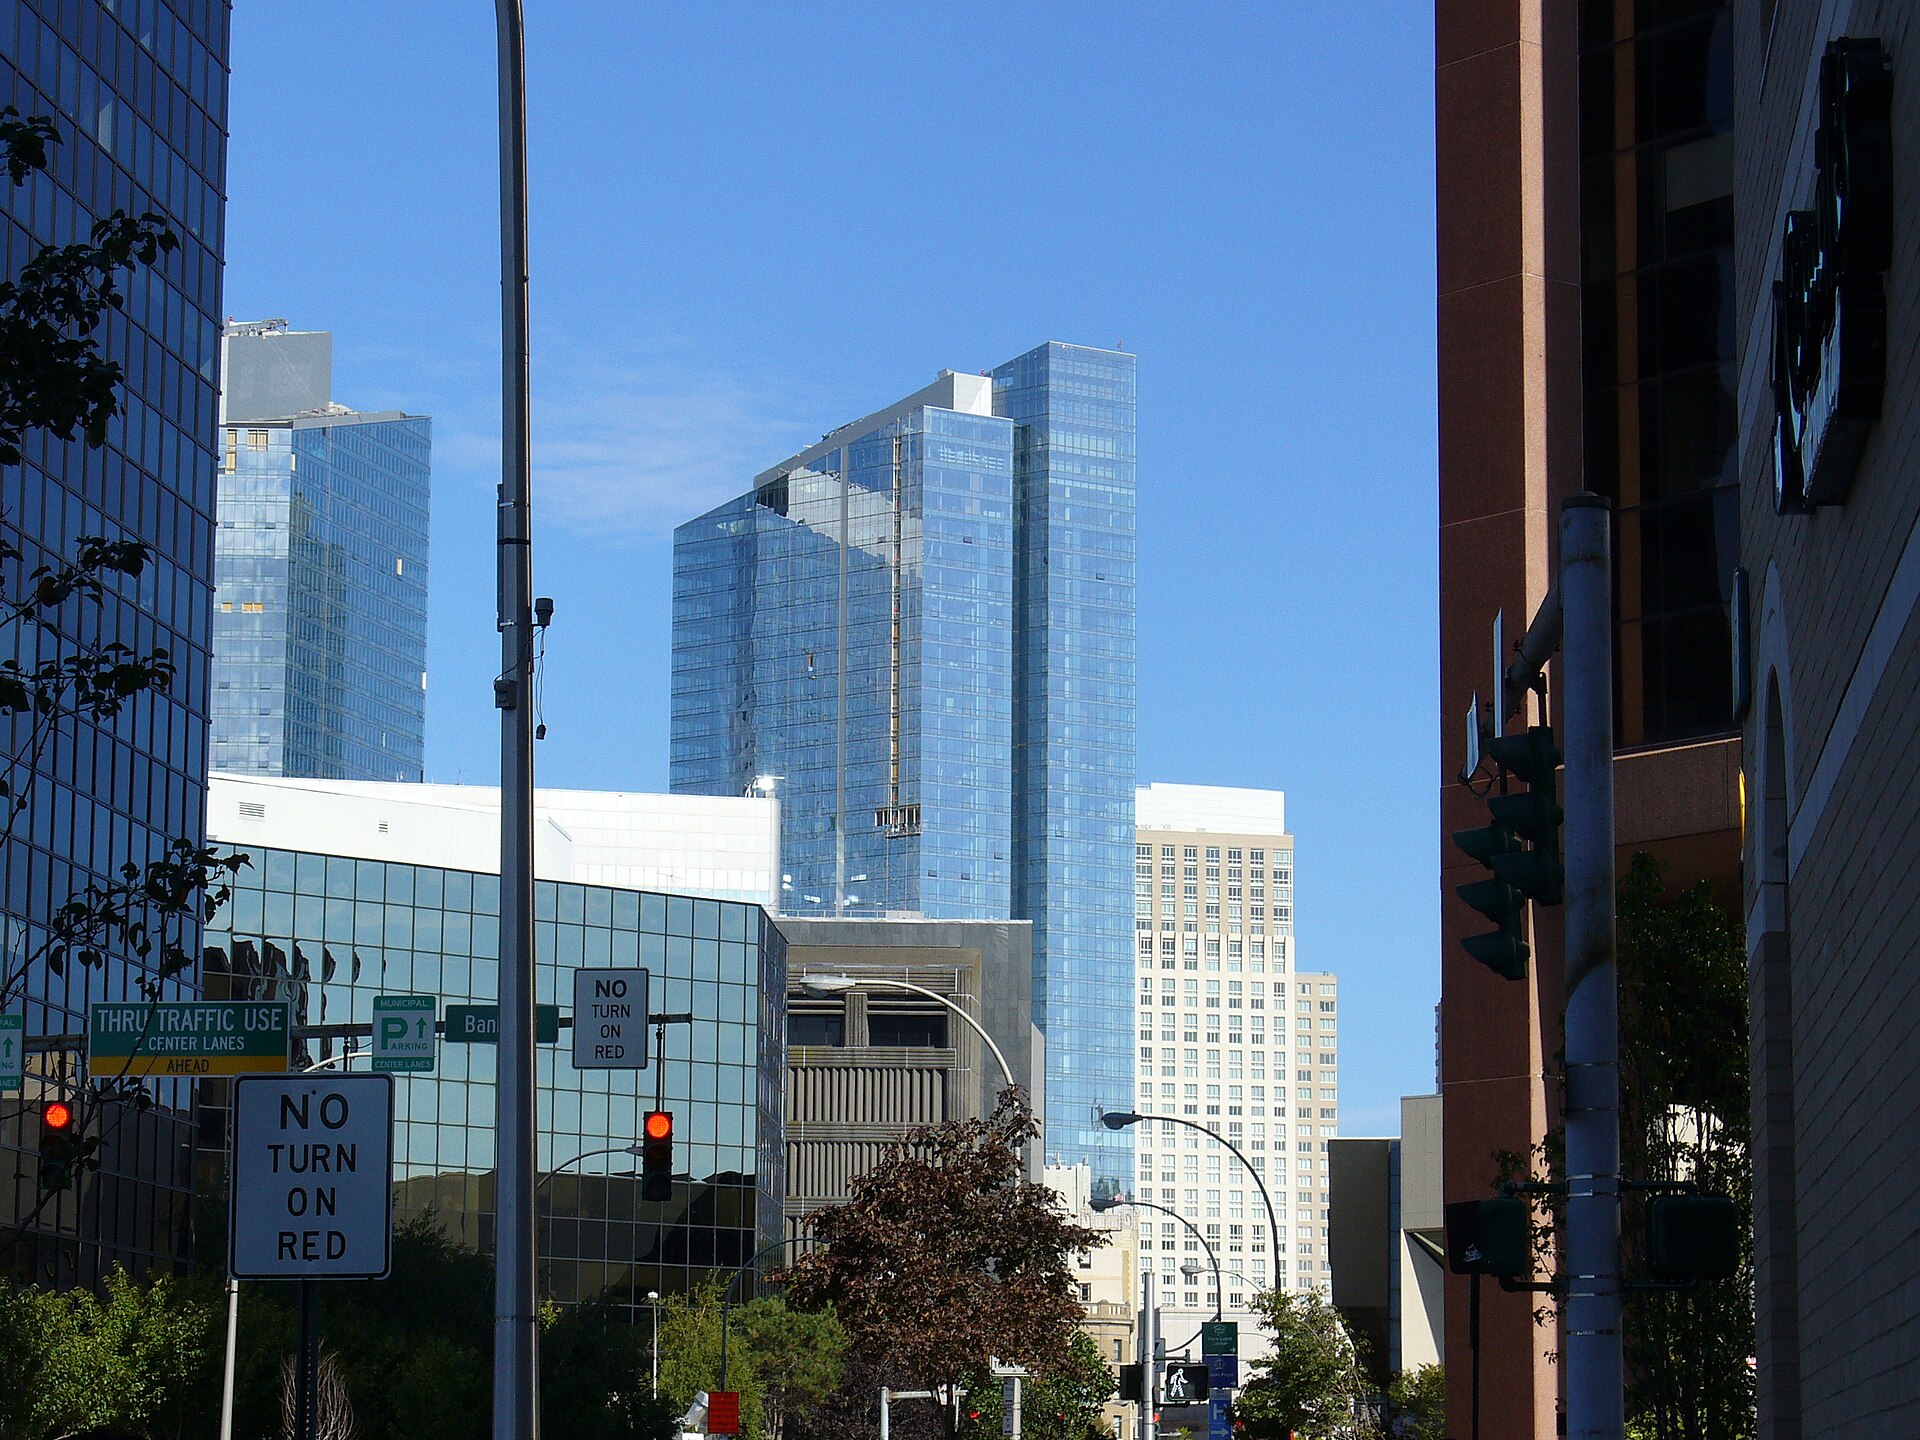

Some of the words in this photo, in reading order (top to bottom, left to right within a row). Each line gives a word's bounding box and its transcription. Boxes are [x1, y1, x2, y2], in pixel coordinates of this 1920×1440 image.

[594, 979, 627, 998] NO
[380, 999, 428, 1007] MUNICIPAL
[592, 1004, 631, 1019] TURN
[97, 1008, 149, 1032] THRU
[157, 1008, 235, 1032] TRAFFIC
[244, 1008, 282, 1031] USE
[600, 1024, 620, 1039] ON
[148, 1036, 197, 1051] CENTER
[203, 1036, 245, 1051] LANES
[594, 1045, 624, 1059] RED
[166, 1059, 209, 1073] AHEAD
[279, 1093, 349, 1130] NO
[267, 1143, 357, 1173] TURN
[287, 1186, 336, 1217] ON
[278, 1231, 347, 1261] RED
